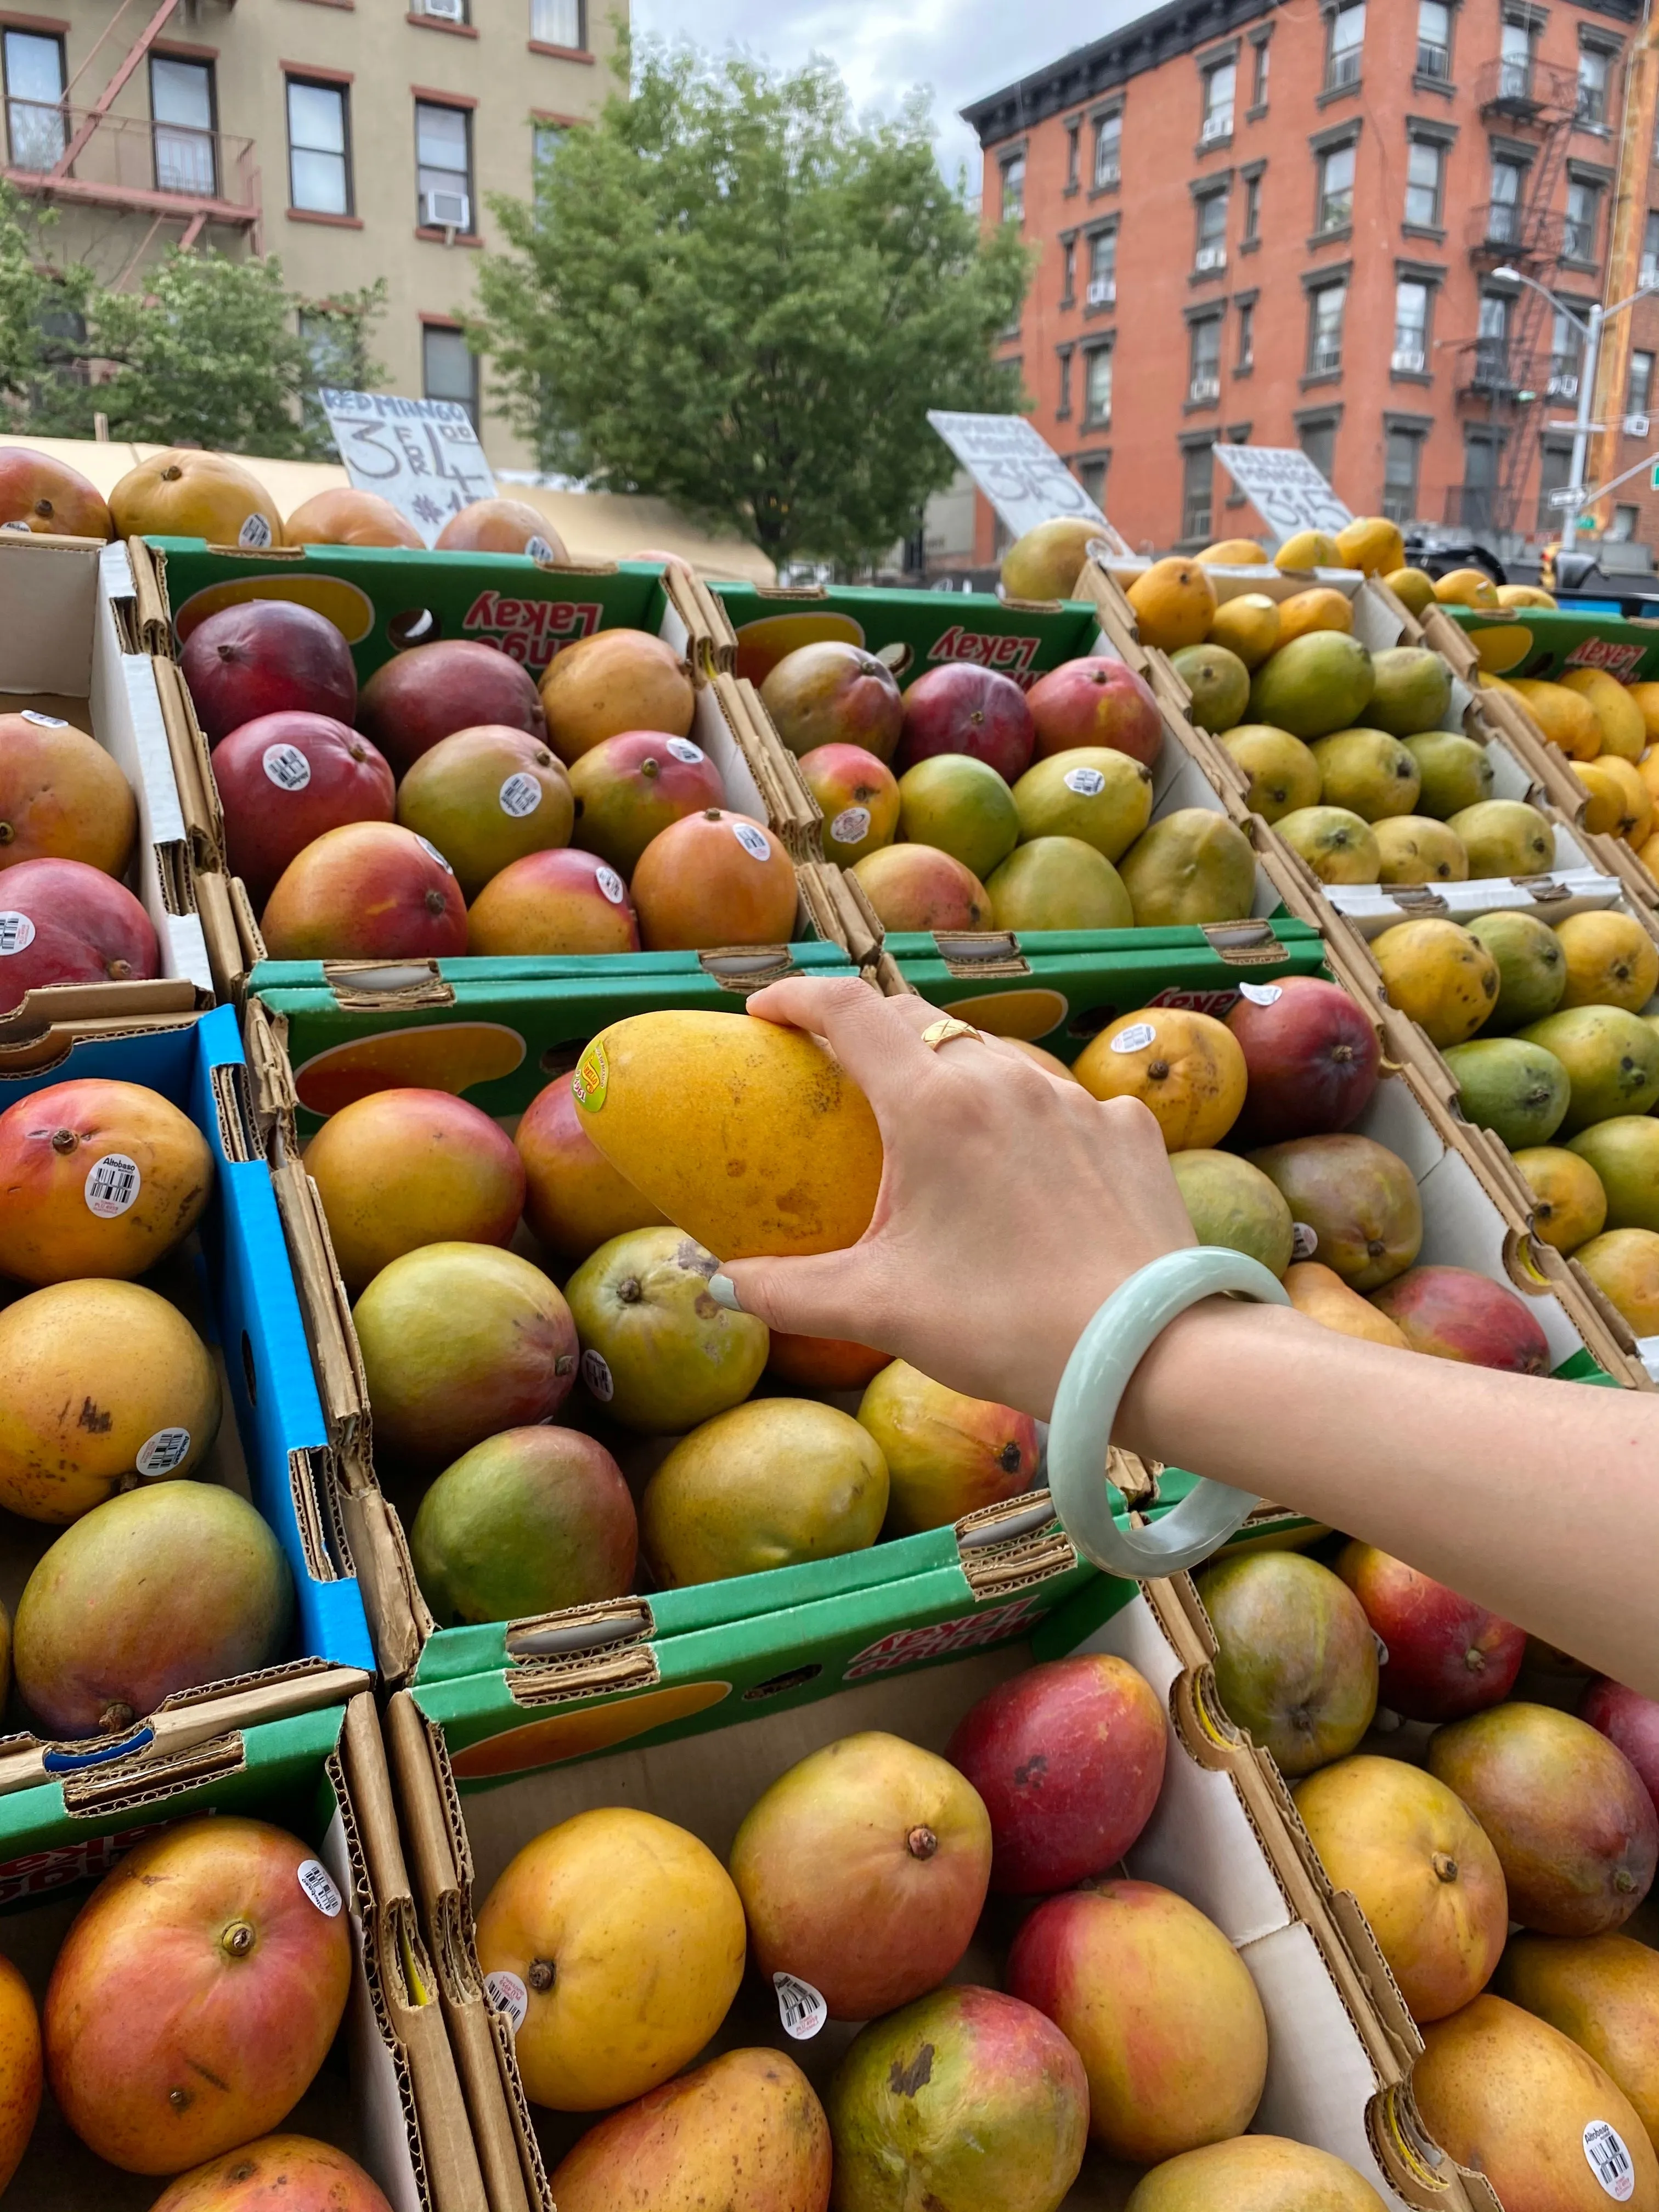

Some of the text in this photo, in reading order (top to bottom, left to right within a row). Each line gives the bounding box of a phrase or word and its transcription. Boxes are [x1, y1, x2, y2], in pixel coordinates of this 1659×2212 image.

[334, 416, 401, 479] 3
[462, 590, 603, 638] Lakay
[927, 626, 1041, 672] Lakay
[1564, 636, 1648, 673] Lakay
[1145, 986, 1246, 1015] akay
[103, 1157, 136, 1171] Altobaso
[848, 1594, 1041, 1664] Lakay
[302, 1878, 324, 1910] Altobaso
